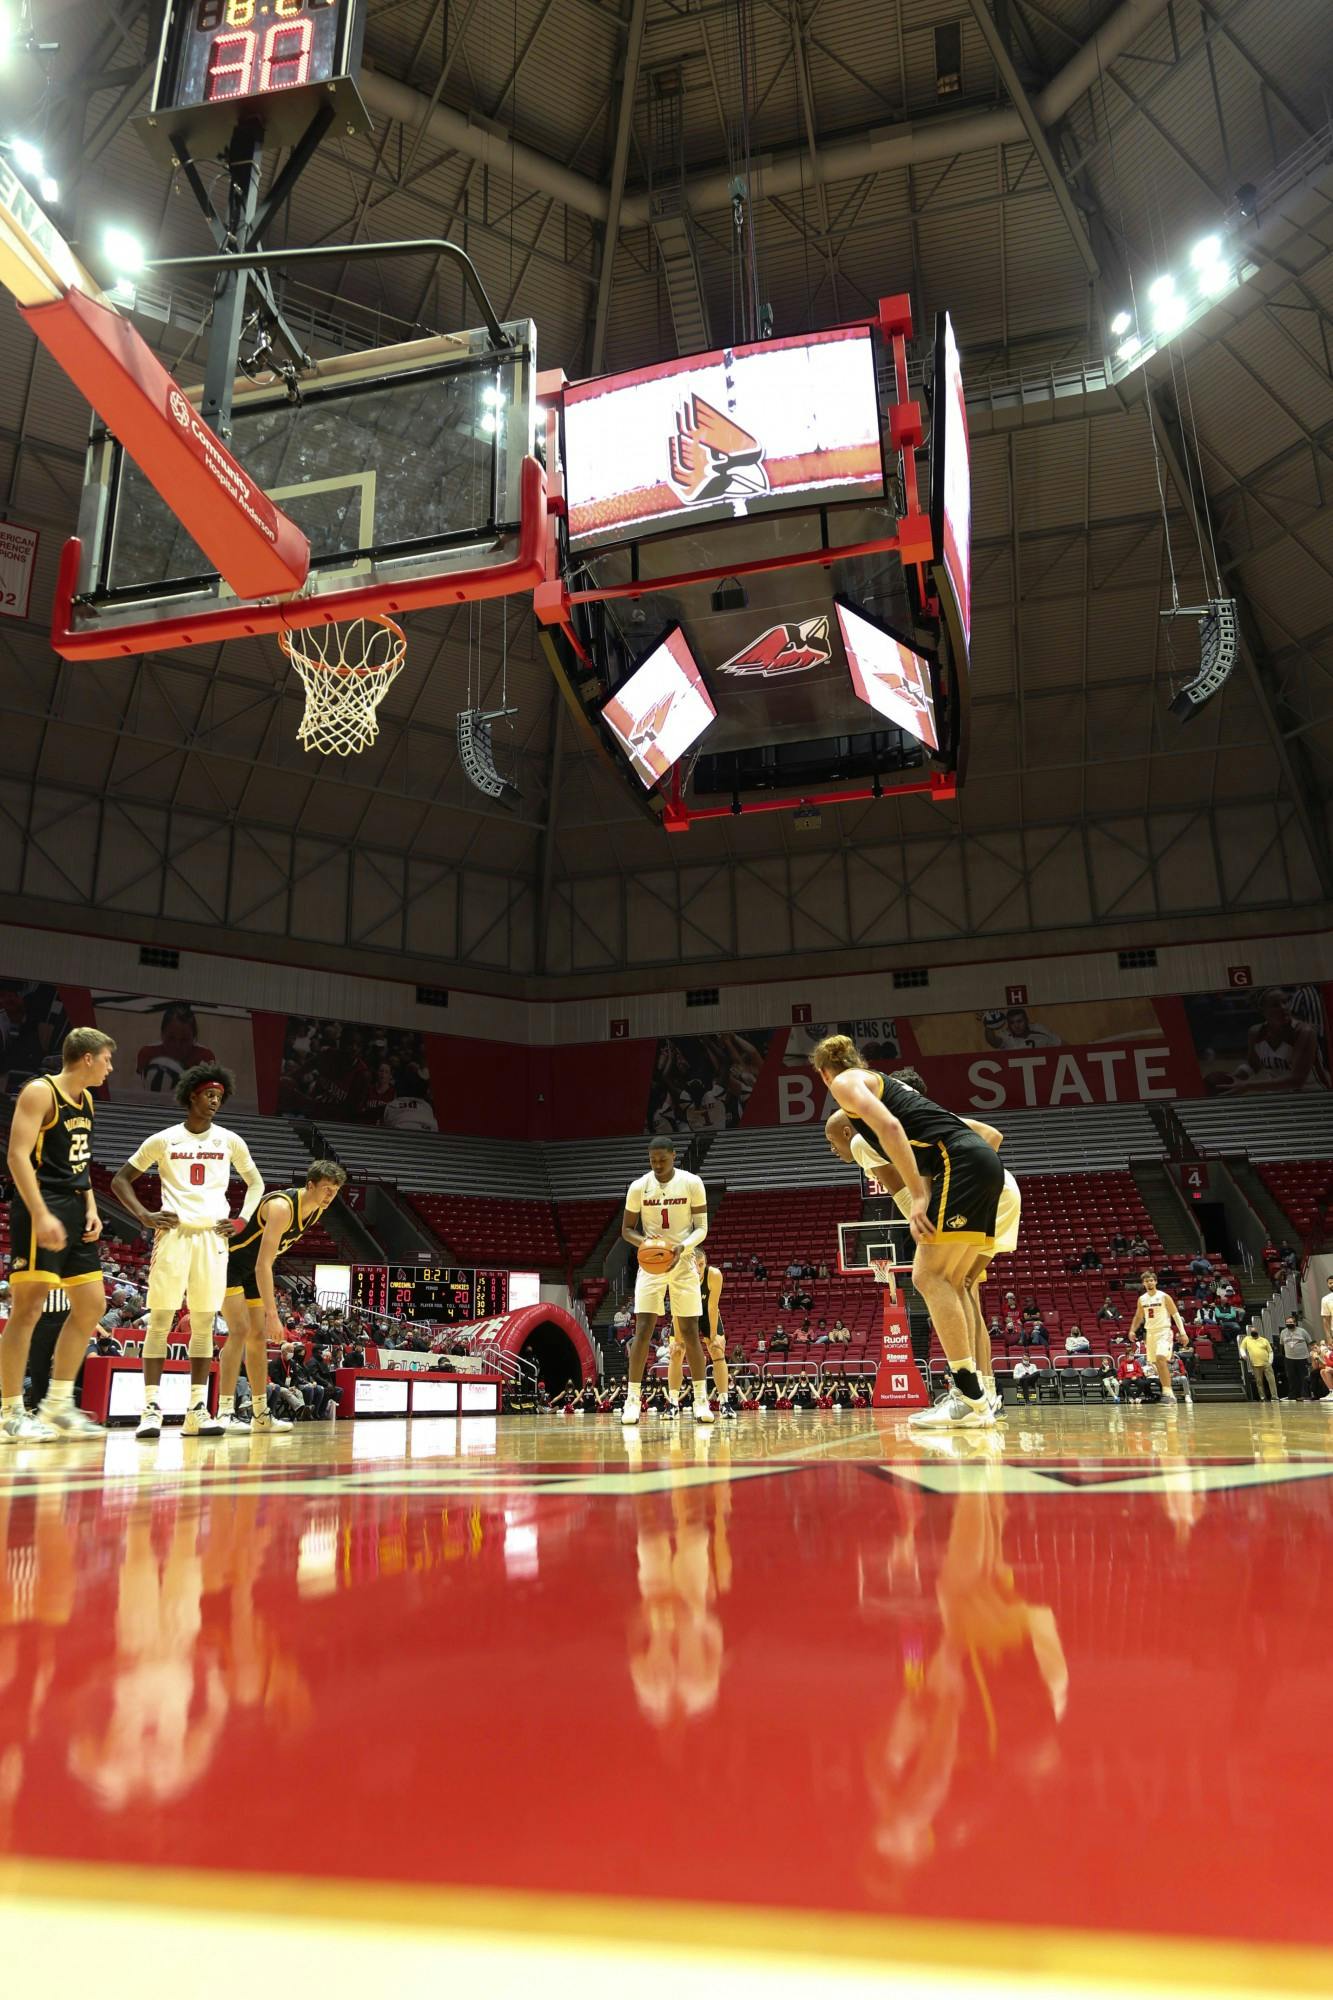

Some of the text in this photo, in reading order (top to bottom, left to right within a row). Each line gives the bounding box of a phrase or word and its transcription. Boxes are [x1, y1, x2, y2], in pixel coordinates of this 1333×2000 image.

[207, 18, 314, 101] 30
[191, 420, 250, 499] Community
[205, 453, 275, 541] Hospital Anderson
[1234, 971, 1248, 985] G
[1010, 990, 1024, 1004] H
[615, 1023, 624, 1037] J
[967, 1046, 1177, 1110] STATE
[69, 1133, 91, 1161] 22
[170, 1151, 224, 1160] BALL STATE
[190, 1163, 205, 1185] 0
[1187, 1171, 1203, 1187] 4
[348, 1192, 359, 1208] 7
[663, 1197, 687, 1206] STATE
[661, 1208, 670, 1229] 1
[423, 1268, 448, 1282] 8:21
[396, 1289, 411, 1302] 20
[454, 1291, 469, 1304] 20
[408, 1307, 415, 1317] 4
[447, 1309, 454, 1317] 4
[462, 1309, 469, 1317] 4
[883, 1335, 909, 1344] Ruoff
